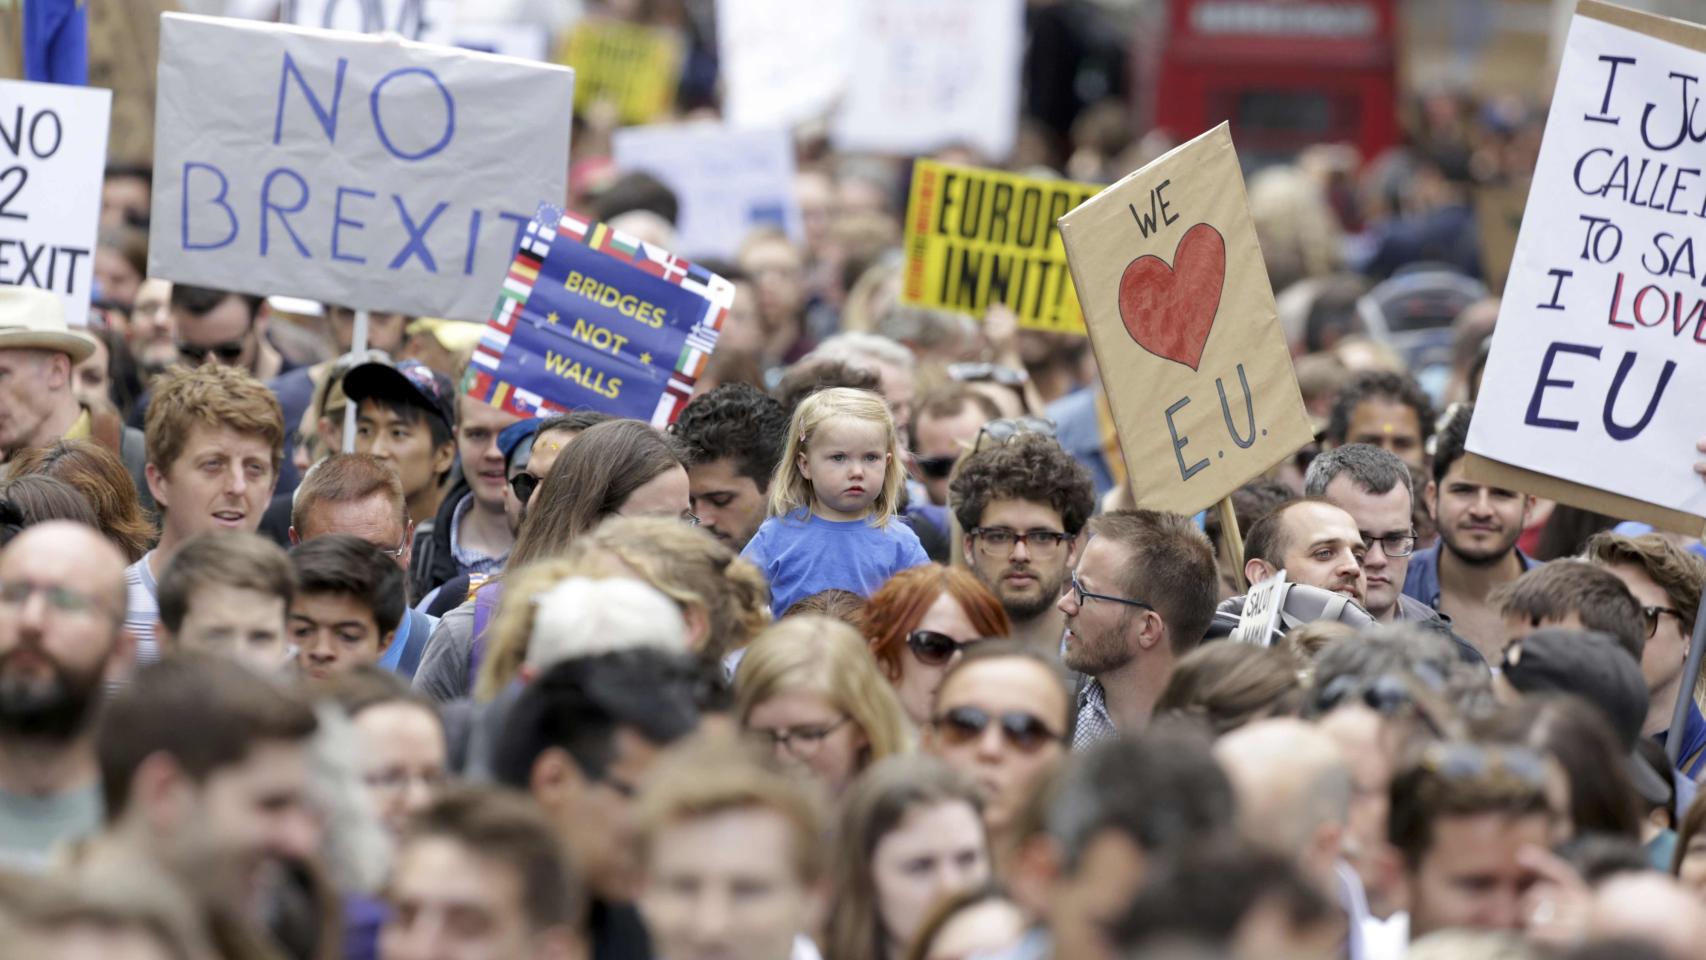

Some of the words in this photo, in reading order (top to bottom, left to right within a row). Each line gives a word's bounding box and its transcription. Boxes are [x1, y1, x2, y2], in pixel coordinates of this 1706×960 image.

[273, 51, 455, 161] NO
[1584, 55, 1636, 125] I
[0, 165, 28, 220] 2
[938, 174, 1091, 250] EUROP
[1129, 179, 1179, 239] WE
[940, 247, 1067, 321] INNIT!
[1579, 214, 1623, 264] TO
[1641, 232, 1706, 287] SA
[564, 270, 667, 329] BRIDGES
[1536, 267, 1573, 311] I
[571, 318, 628, 355] NOT
[544, 349, 623, 399] WALLS
[1524, 341, 1678, 442] EU
[1164, 363, 1268, 482] E.U.
